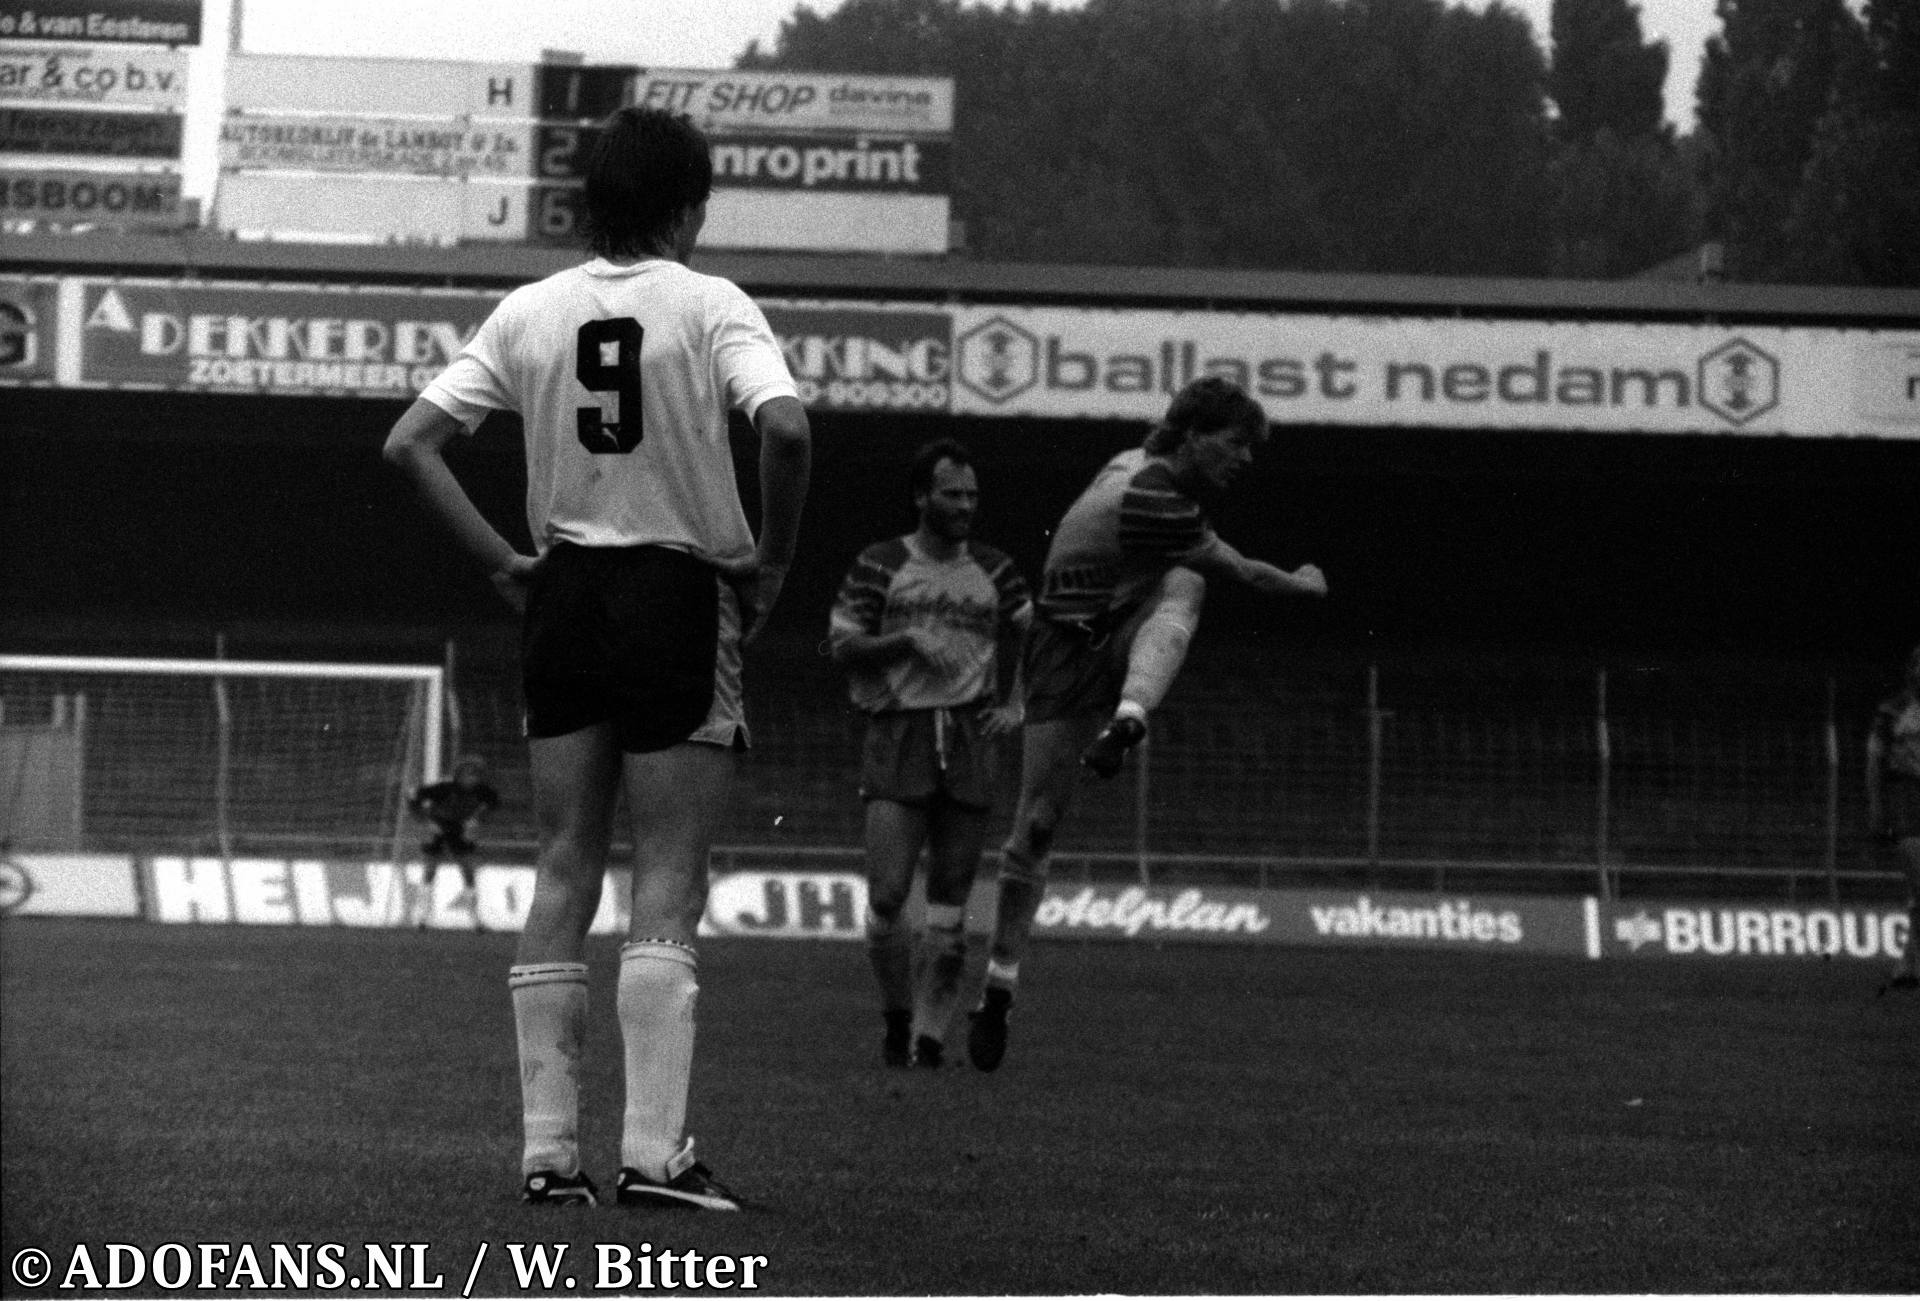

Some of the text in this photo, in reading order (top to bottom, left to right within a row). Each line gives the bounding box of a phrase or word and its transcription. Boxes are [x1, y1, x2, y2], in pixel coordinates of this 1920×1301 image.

[40, 16, 85, 35] van
[42, 55, 64, 87] &
[74, 67, 117, 91] co
[487, 78, 513, 106] H
[647, 81, 816, 114] FIT SHOP
[544, 130, 577, 174] 2
[712, 140, 921, 186] nroprint
[487, 197, 508, 226] J
[85, 288, 137, 332] A
[576, 317, 644, 454] 9
[1046, 336, 1692, 409] ballast nedam
[1034, 888, 1523, 943] otelplan vakanties
